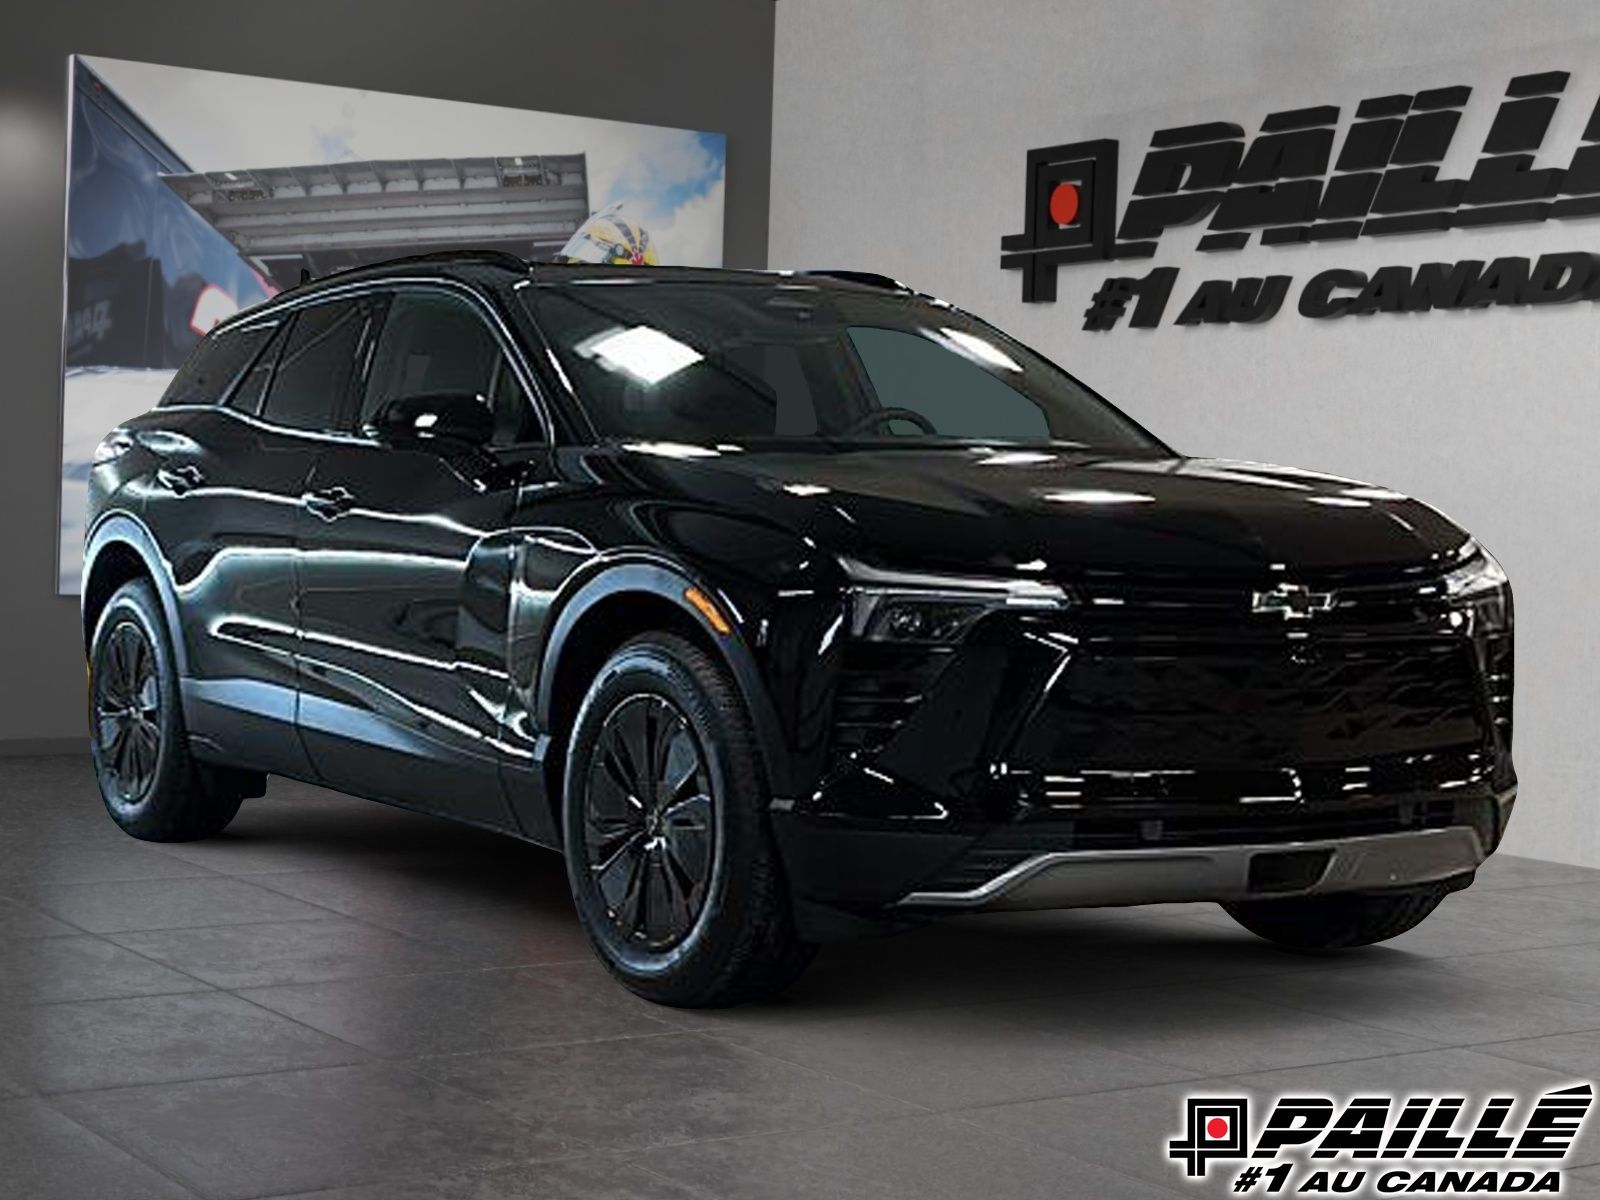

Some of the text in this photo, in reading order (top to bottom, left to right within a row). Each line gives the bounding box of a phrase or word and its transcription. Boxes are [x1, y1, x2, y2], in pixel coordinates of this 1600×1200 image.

[1082, 251, 1600, 331] #1 AU CANAD
